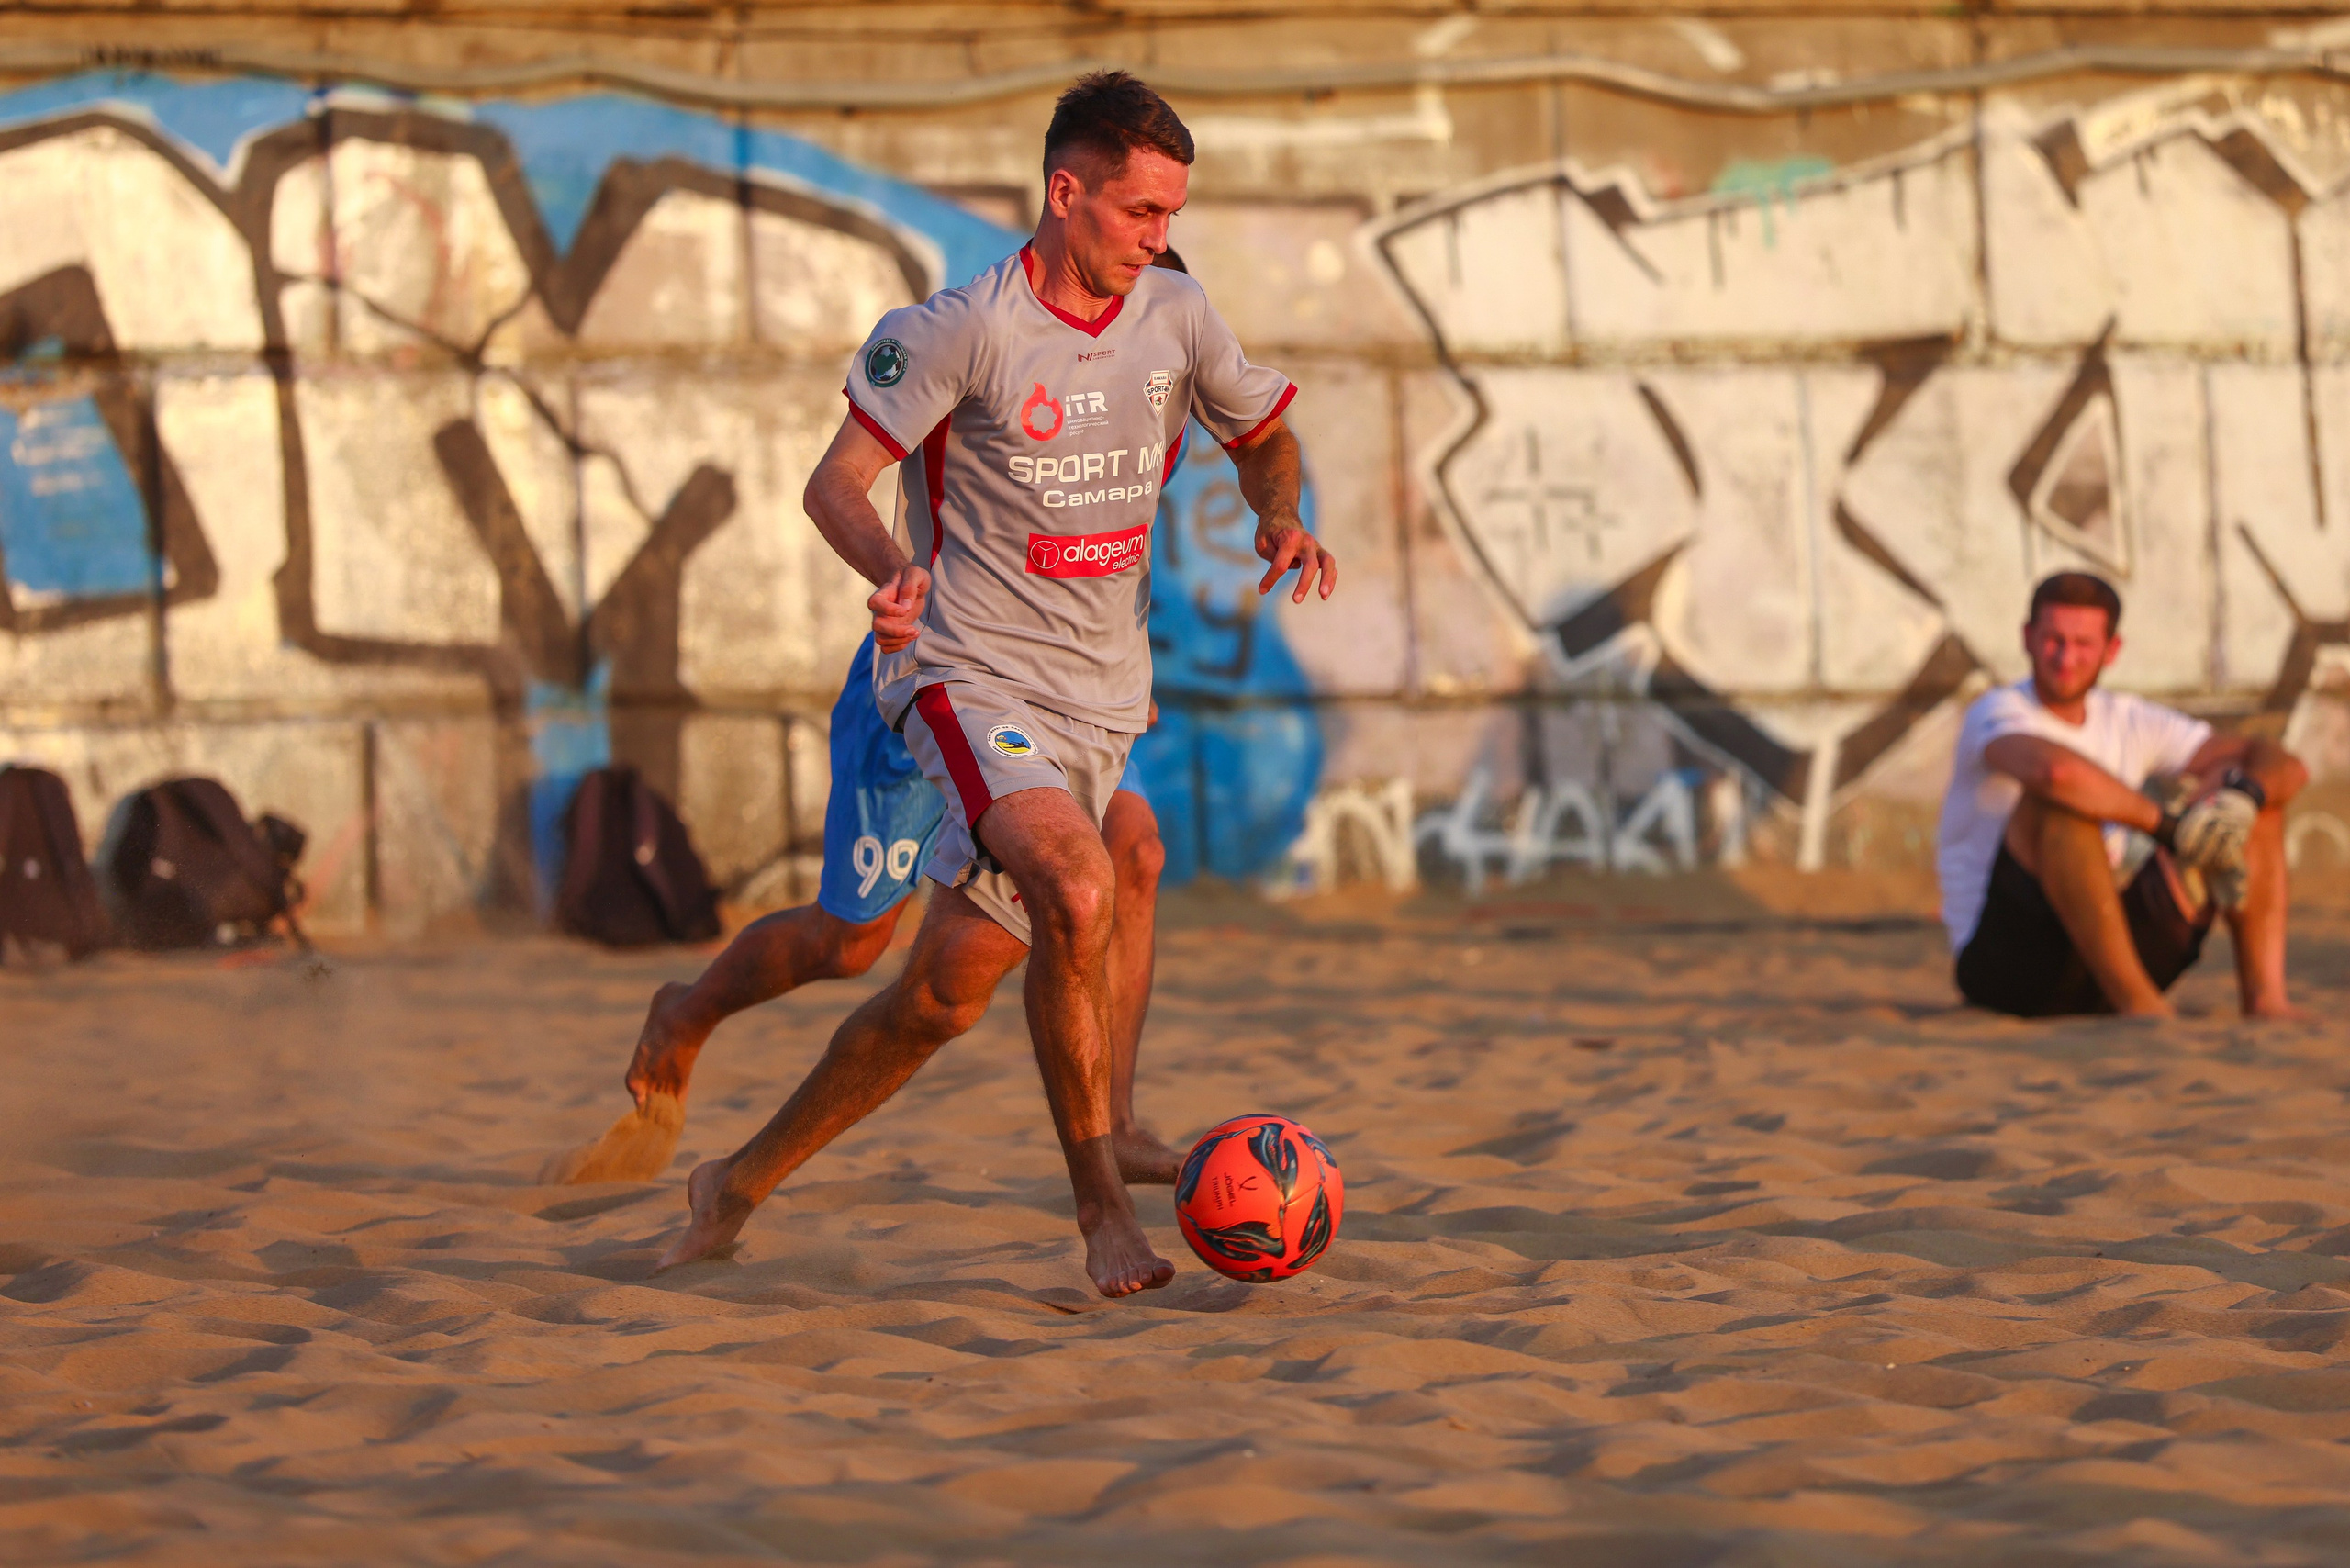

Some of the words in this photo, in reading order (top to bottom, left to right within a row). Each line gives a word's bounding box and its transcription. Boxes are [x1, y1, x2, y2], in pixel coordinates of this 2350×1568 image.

[1093, 349, 1116, 357] SPORT
[1007, 449, 1128, 484] SPORT
[1042, 480, 1153, 508] Самара
[1063, 534, 1144, 566] alageum
[1112, 553, 1140, 570] electric
[1212, 1176, 1224, 1211] TRIUMPH
